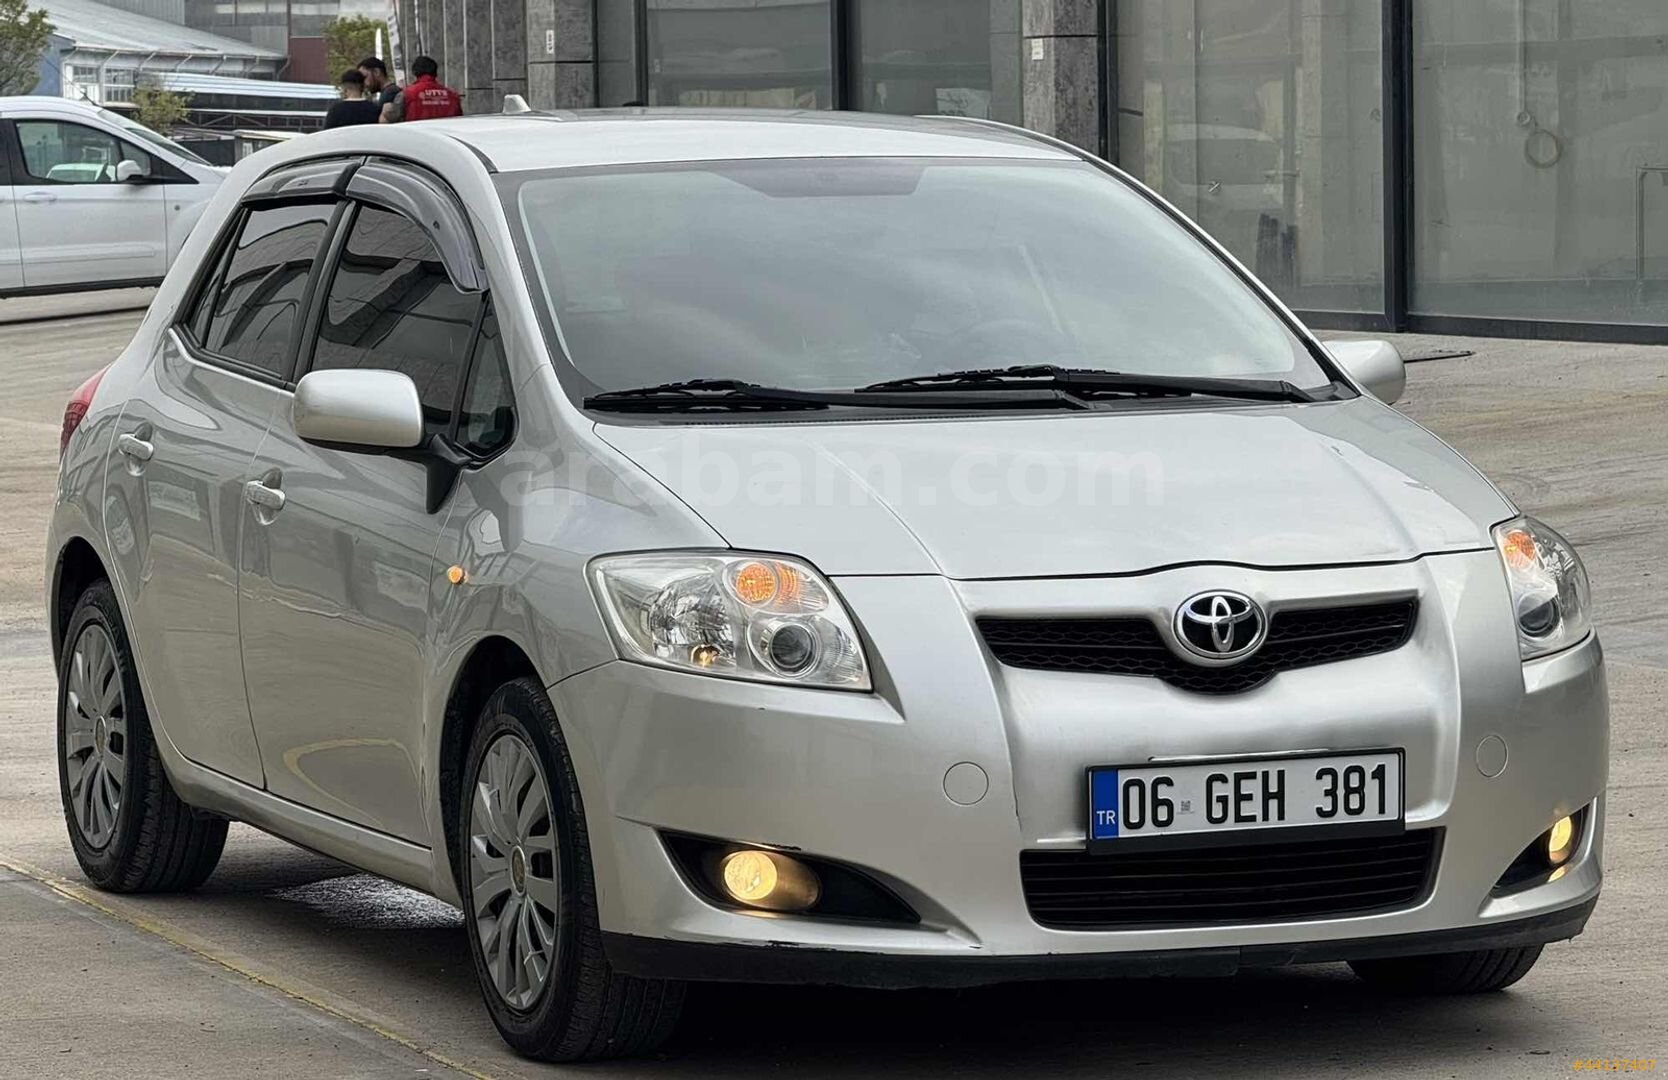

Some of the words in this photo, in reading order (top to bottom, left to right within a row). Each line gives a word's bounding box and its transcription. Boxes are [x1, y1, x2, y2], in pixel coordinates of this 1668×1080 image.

[1122, 776, 1174, 830] 06
[1205, 769, 1286, 824] GEH
[1315, 763, 1386, 818] 381
[1096, 810, 1116, 826] TR
